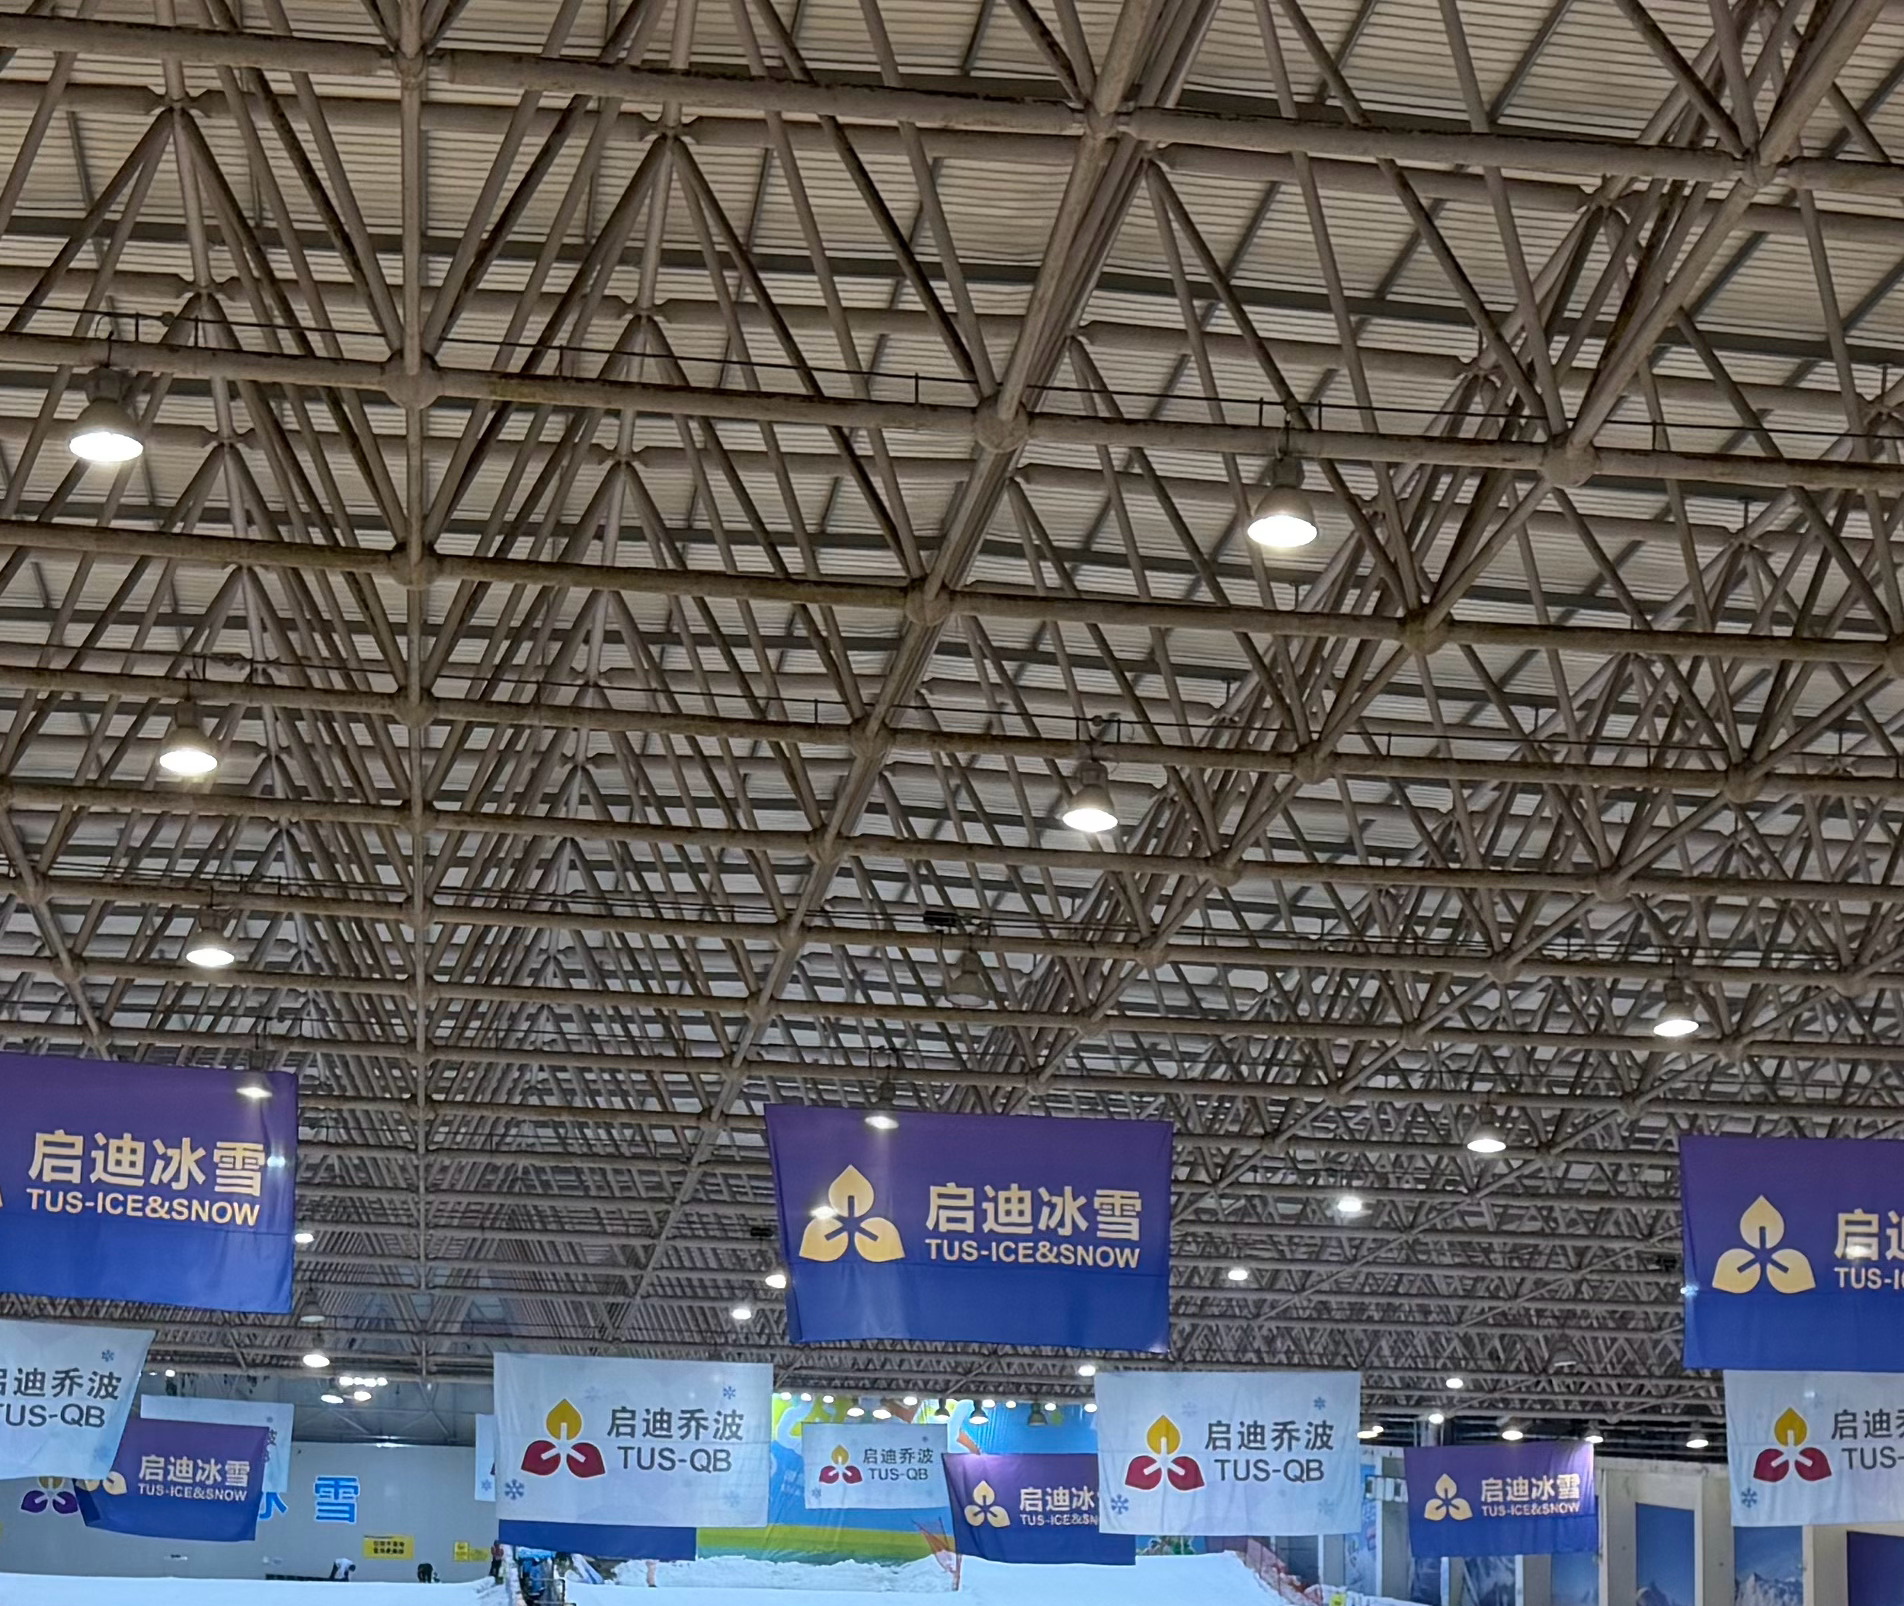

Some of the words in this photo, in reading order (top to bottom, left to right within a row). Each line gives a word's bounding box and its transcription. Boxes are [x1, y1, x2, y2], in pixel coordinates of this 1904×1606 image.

[28, 1129, 266, 1198] 启迪冰雪
[26, 1188, 260, 1227] TUS-ICE&SNOW
[926, 1182, 1143, 1242] 启迪冰雪
[925, 1239, 1140, 1269] TUS-ICE&SNOW
[607, 1406, 744, 1442] 启迪乔波
[1204, 1420, 1334, 1453] 启迪乔波
[617, 1446, 732, 1473] TUS-QB
[863, 1447, 933, 1464] 启迪乔波
[1214, 1459, 1324, 1482] TUS-QB
[138, 1454, 250, 1488] 启迪冰雪
[869, 1467, 928, 1481] TUS-QB
[138, 1483, 247, 1502] TUS-ICE&SNOW
[1019, 1486, 1099, 1512] 启迪冰
[1481, 1473, 1580, 1503] 启迪冰雪
[1481, 1502, 1580, 1517] TUS-ICE&SNOW
